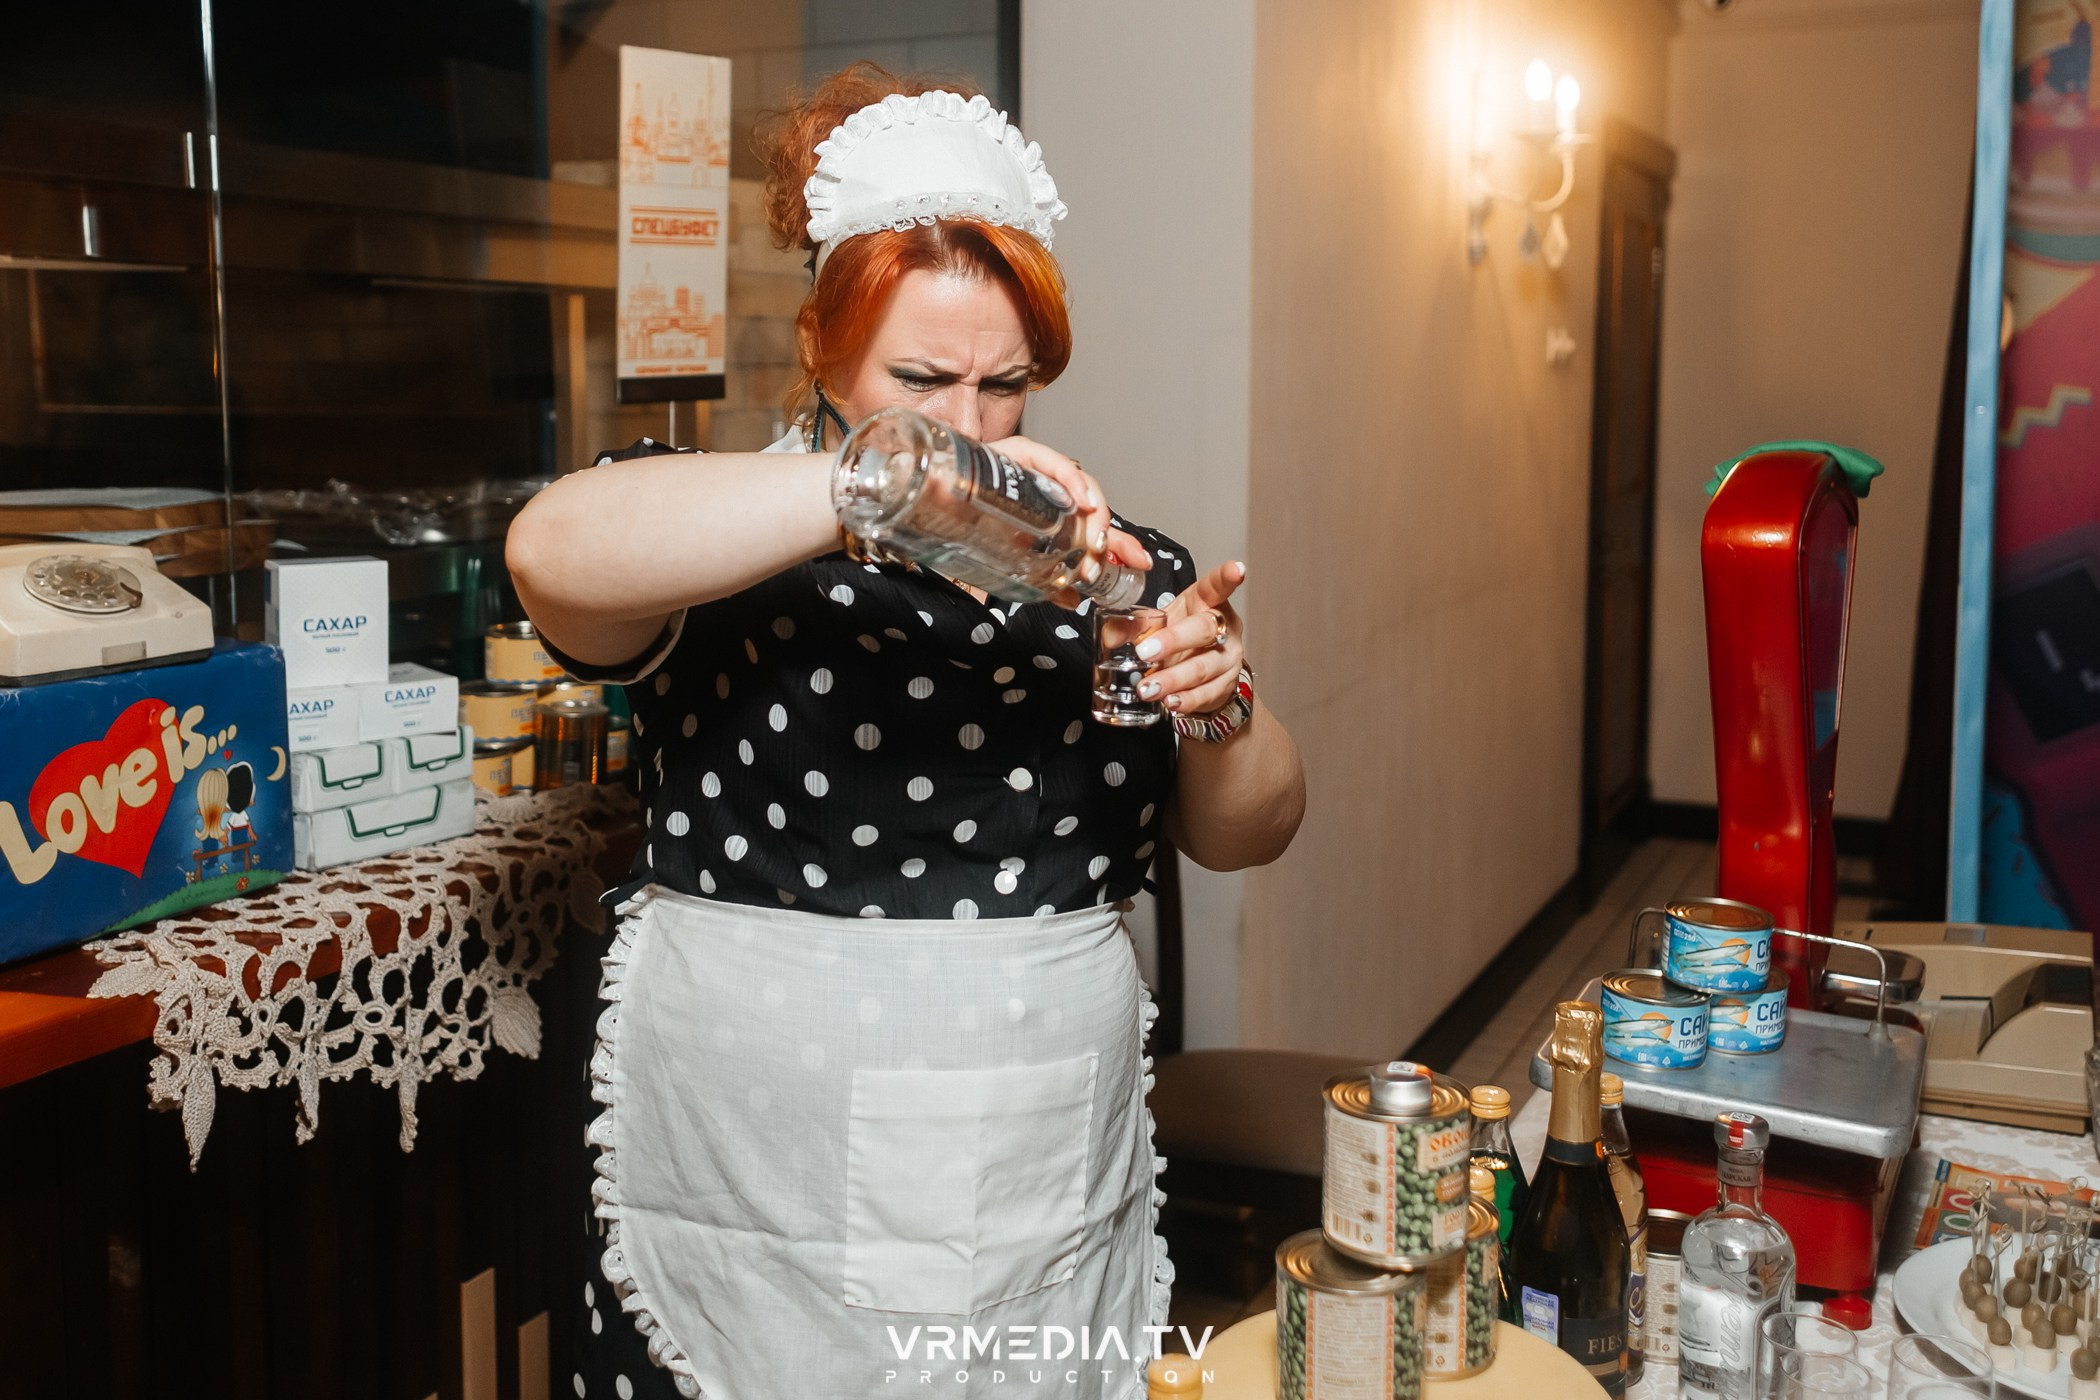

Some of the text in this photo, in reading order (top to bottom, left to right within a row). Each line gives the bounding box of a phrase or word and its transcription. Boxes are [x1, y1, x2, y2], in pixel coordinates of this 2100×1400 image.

[303, 615, 367, 632] САХАР
[384, 686, 436, 703] САХАР
[289, 699, 334, 715] АХАР
[0, 747, 158, 885] Love
